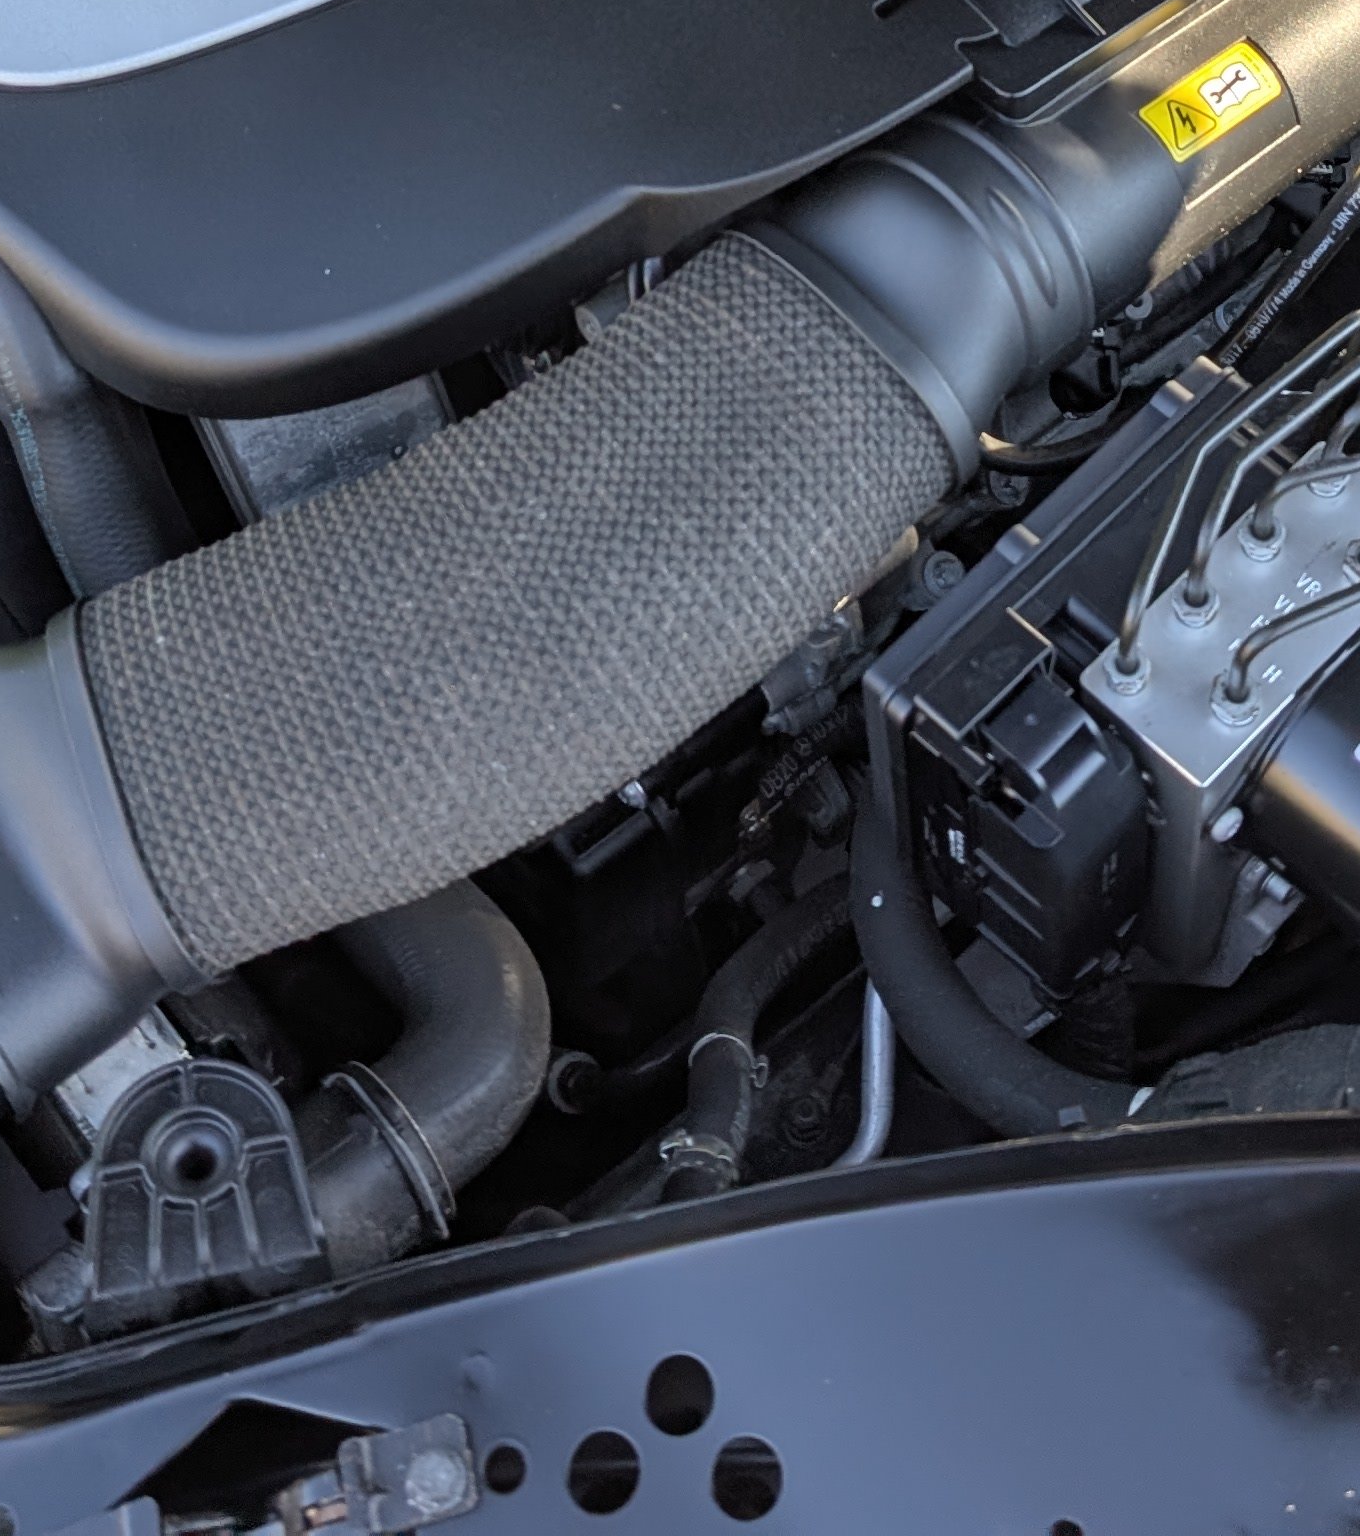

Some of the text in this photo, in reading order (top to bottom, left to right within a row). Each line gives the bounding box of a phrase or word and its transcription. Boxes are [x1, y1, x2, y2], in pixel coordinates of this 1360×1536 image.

[1281, 277, 1299, 300] Made
[1301, 234, 1336, 271] Germany
[1331, 204, 1355, 231] DIN
[1296, 572, 1322, 598] VR
